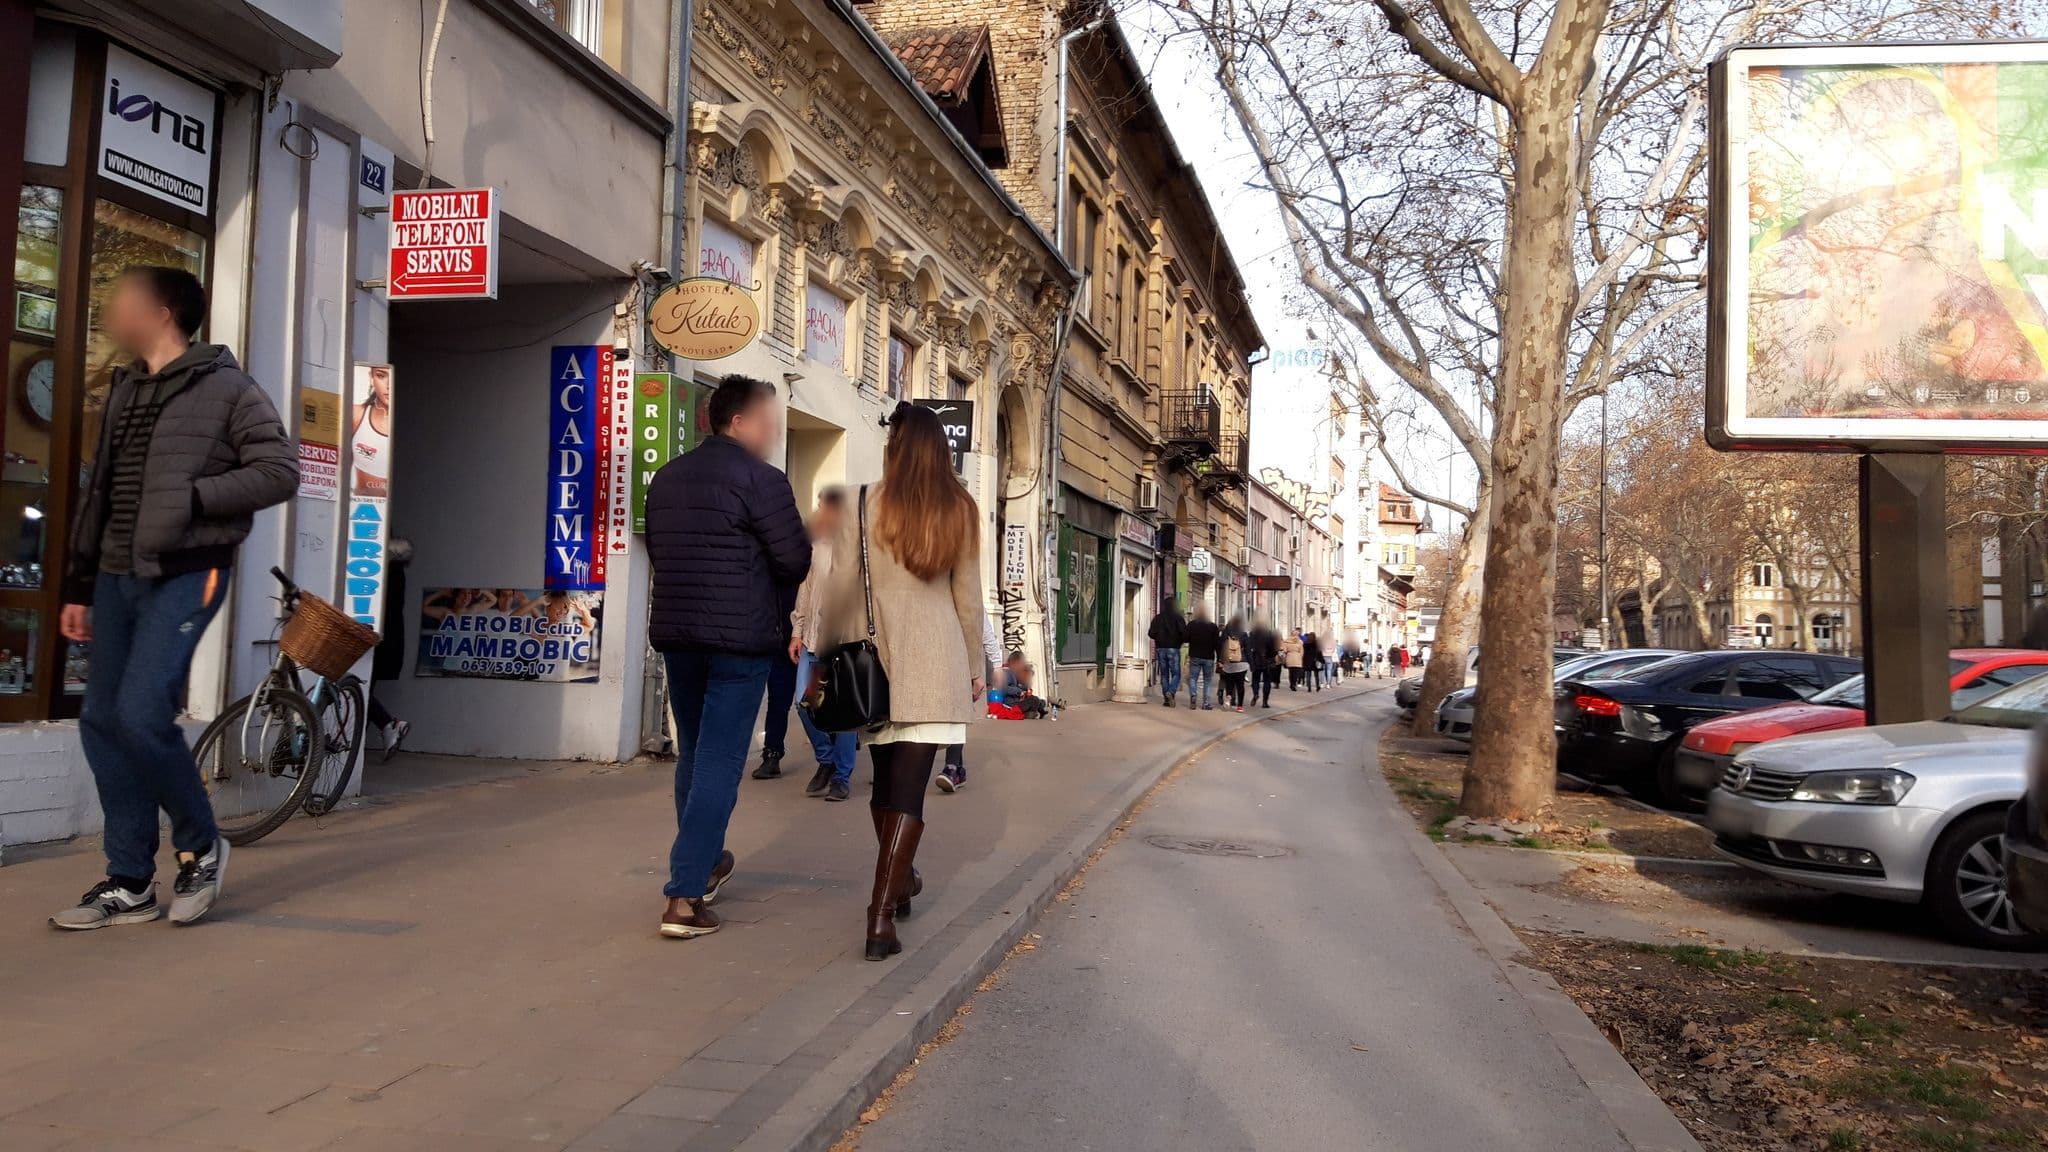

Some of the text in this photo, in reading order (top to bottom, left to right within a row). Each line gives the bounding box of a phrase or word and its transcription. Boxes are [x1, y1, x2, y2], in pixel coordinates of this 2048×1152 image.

[109, 78, 206, 154] iona
[107, 152, 201, 204] WWW.IONASATOVI.COM
[366, 162, 381, 188] 22
[402, 194, 479, 220] MOBILNI
[396, 221, 485, 247] TELEFONI
[406, 248, 473, 273] SERVIS
[681, 285, 729, 296] HOSTEL
[656, 298, 752, 336] Kutak
[681, 346, 726, 355] NOVI SAD
[602, 351, 612, 415] Centar
[298, 444, 337, 462] SERVIS
[552, 352, 586, 575] ACADEMY
[613, 369, 630, 538] MOBILNI TELEFONI
[642, 404, 659, 506] ROOM
[301, 474, 337, 488] ELEFONA
[1007, 531, 1015, 579] MOBILNI
[440, 615, 584, 636] AEROBIC club
[430, 633, 589, 663] MAMBOBIC
[461, 660, 556, 675] 063/589-107
